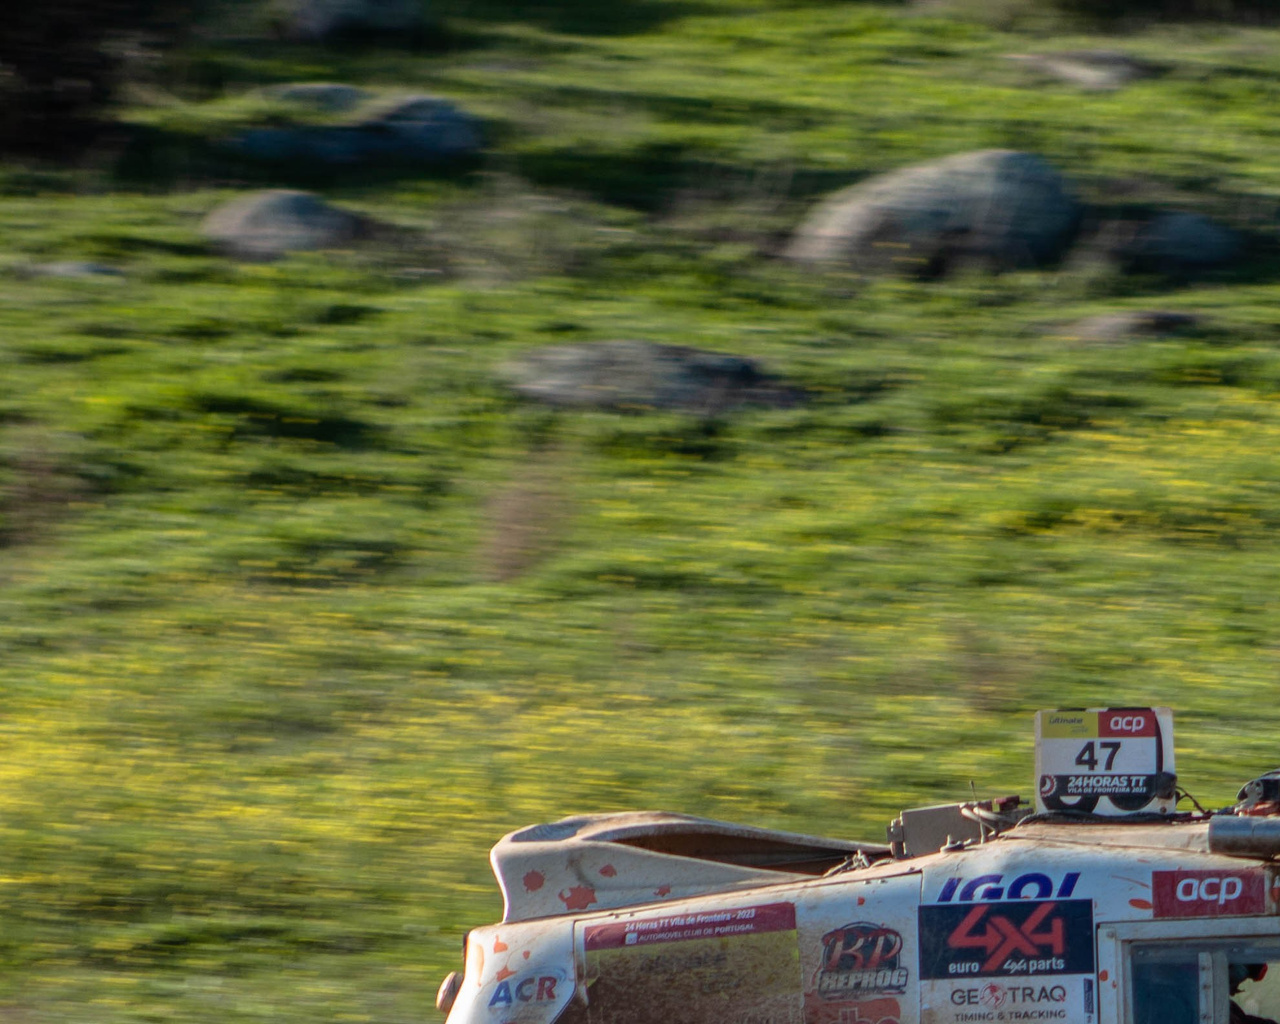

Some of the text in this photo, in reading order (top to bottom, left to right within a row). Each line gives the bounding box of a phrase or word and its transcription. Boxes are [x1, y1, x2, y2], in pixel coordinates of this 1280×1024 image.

[1110, 716, 1145, 732] acp
[1074, 740, 1122, 772] 47
[1129, 775, 1147, 786] TT
[1175, 877, 1243, 905] acp
[625, 922, 635, 932] 24
[636, 920, 658, 931] Horas
[659, 919, 669, 928] TT
[670, 917, 684, 926] Vila
[686, 916, 695, 925] de
[696, 912, 731, 924] Fronteira
[737, 909, 755, 920] 2023
[683, 929, 702, 939] CLUB
[704, 927, 713, 936] DE
[715, 923, 755, 934] PORTUGAL
[948, 961, 980, 973] euro
[1028, 957, 1065, 973] parts
[820, 968, 908, 991] REPROG
[488, 976, 558, 1007] ACR
[954, 1010, 1066, 1022] TIMING & TRACKING
